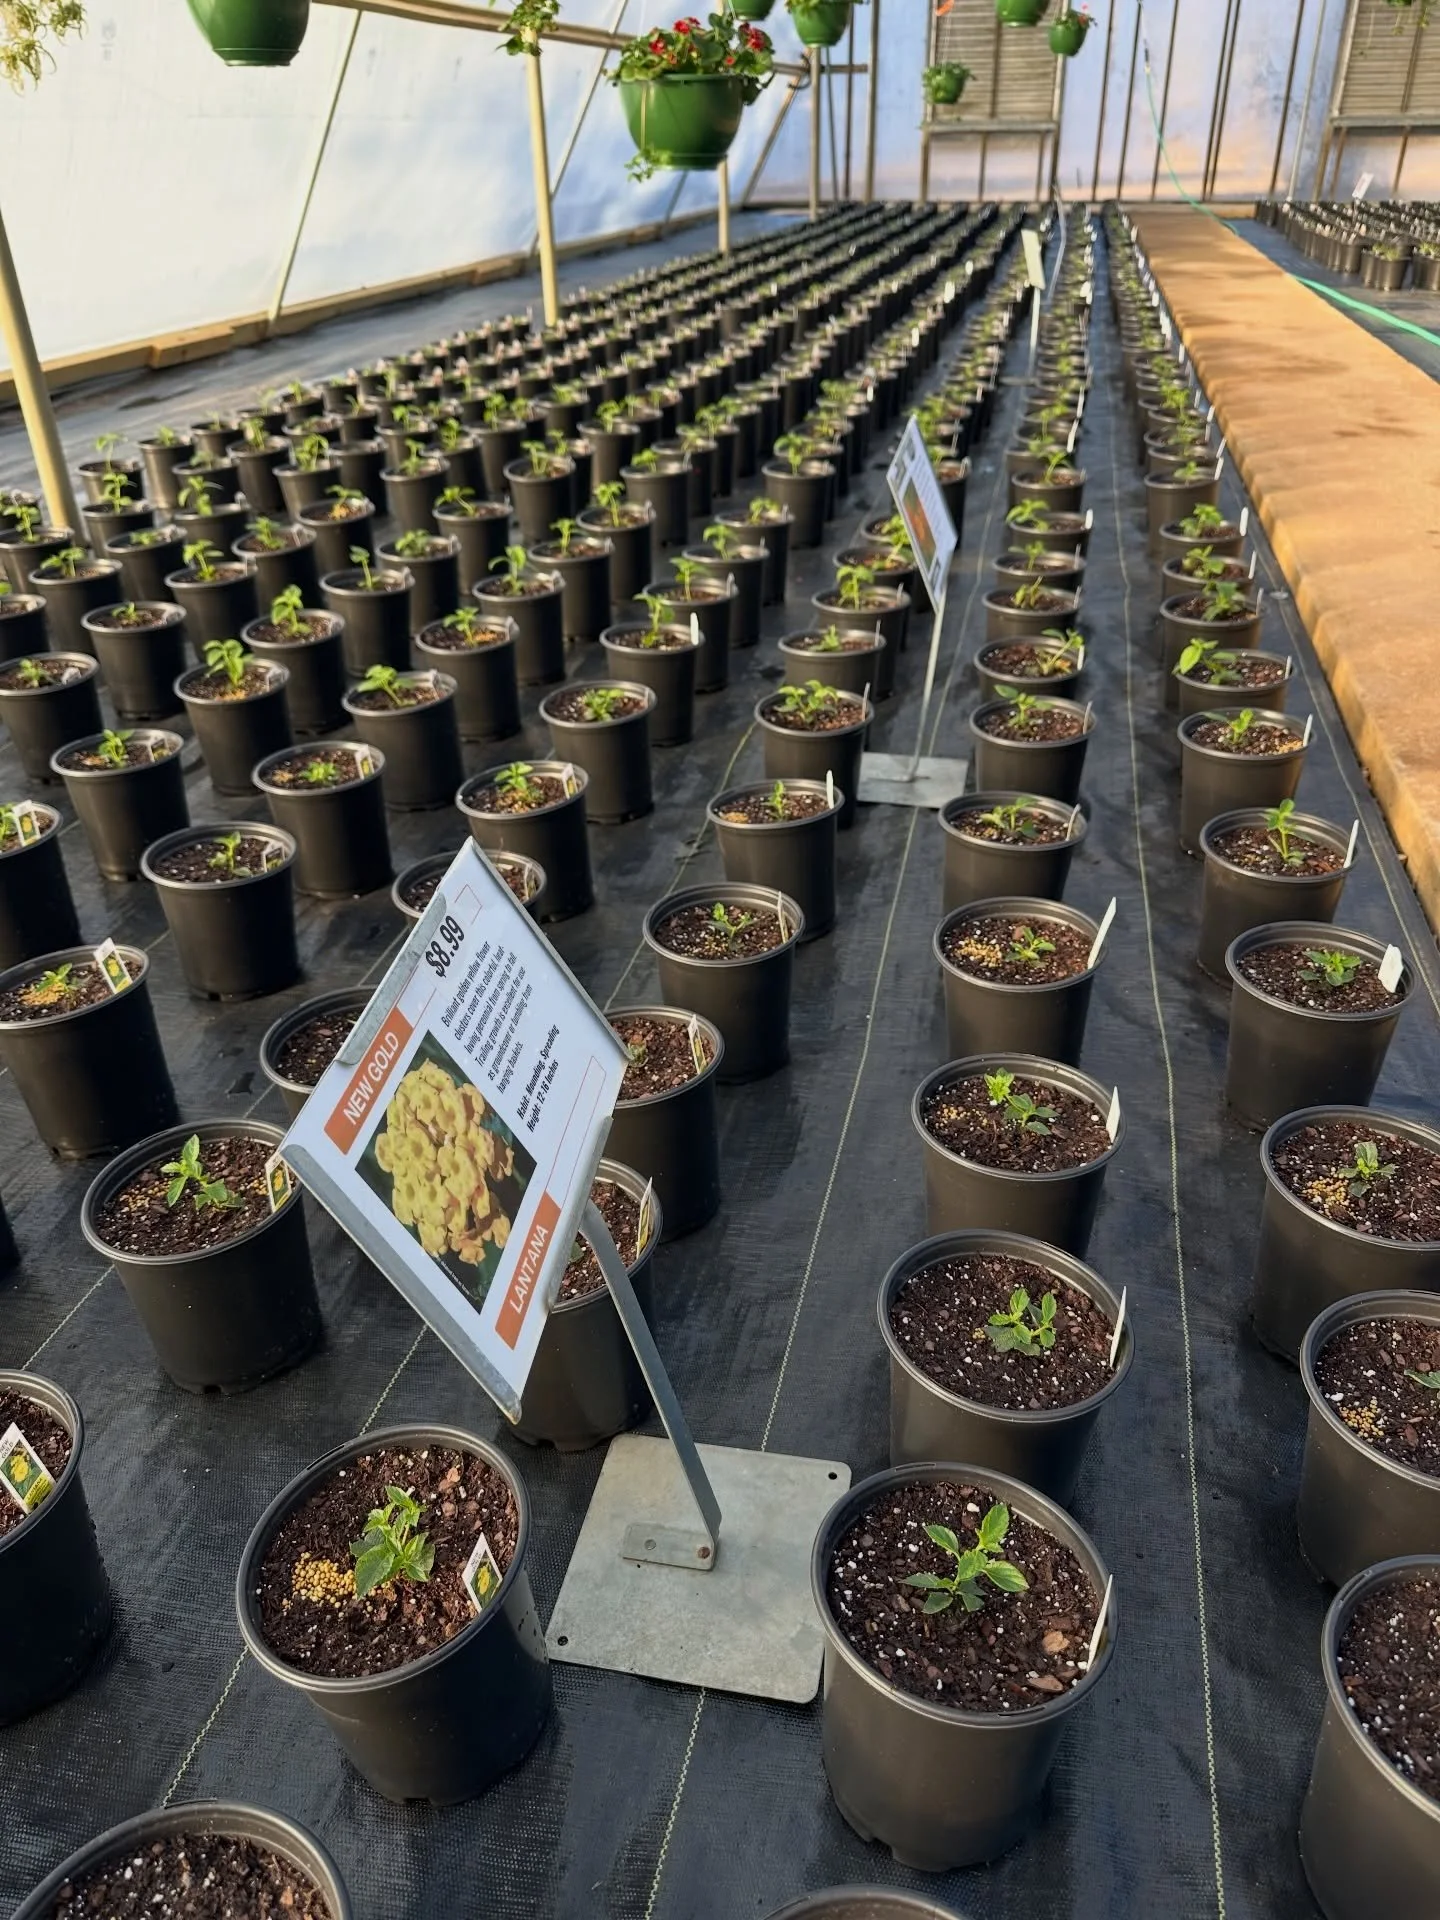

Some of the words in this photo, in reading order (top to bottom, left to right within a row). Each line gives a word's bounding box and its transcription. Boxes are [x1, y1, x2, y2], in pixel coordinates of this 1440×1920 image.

[425, 915, 465, 978] $8.99
[440, 997, 461, 1028] Brilliant
[456, 979, 471, 1003] golden
[468, 959, 481, 982] yellow
[475, 940, 491, 962] flower
[454, 1013, 471, 1041] clusters
[468, 995, 480, 1015] cover
[475, 983, 487, 998] this
[463, 1032, 481, 1055] loving
[475, 1000, 493, 1037] perennial
[488, 988, 501, 1007] from
[497, 970, 511, 992] spring
[475, 1040, 494, 1067] Trailing
[488, 1017, 503, 1045] growth
[501, 984, 518, 1015] excellent
[518, 966, 526, 981] use
[491, 1030, 512, 1075] groundcover
[511, 997, 528, 1027] tumbling
[522, 983, 533, 1001] from
[343, 1075, 374, 1125] NEW
[367, 1031, 399, 1082] GOLD
[496, 1065, 514, 1095] hanging
[516, 1095, 530, 1120] Habit:
[540, 1024, 560, 1060] Spreading
[526, 1102, 542, 1133] Height:
[536, 1083, 550, 1105] 12-16
[544, 1059, 559, 1085] Inches
[510, 1224, 549, 1314] LANTANA
